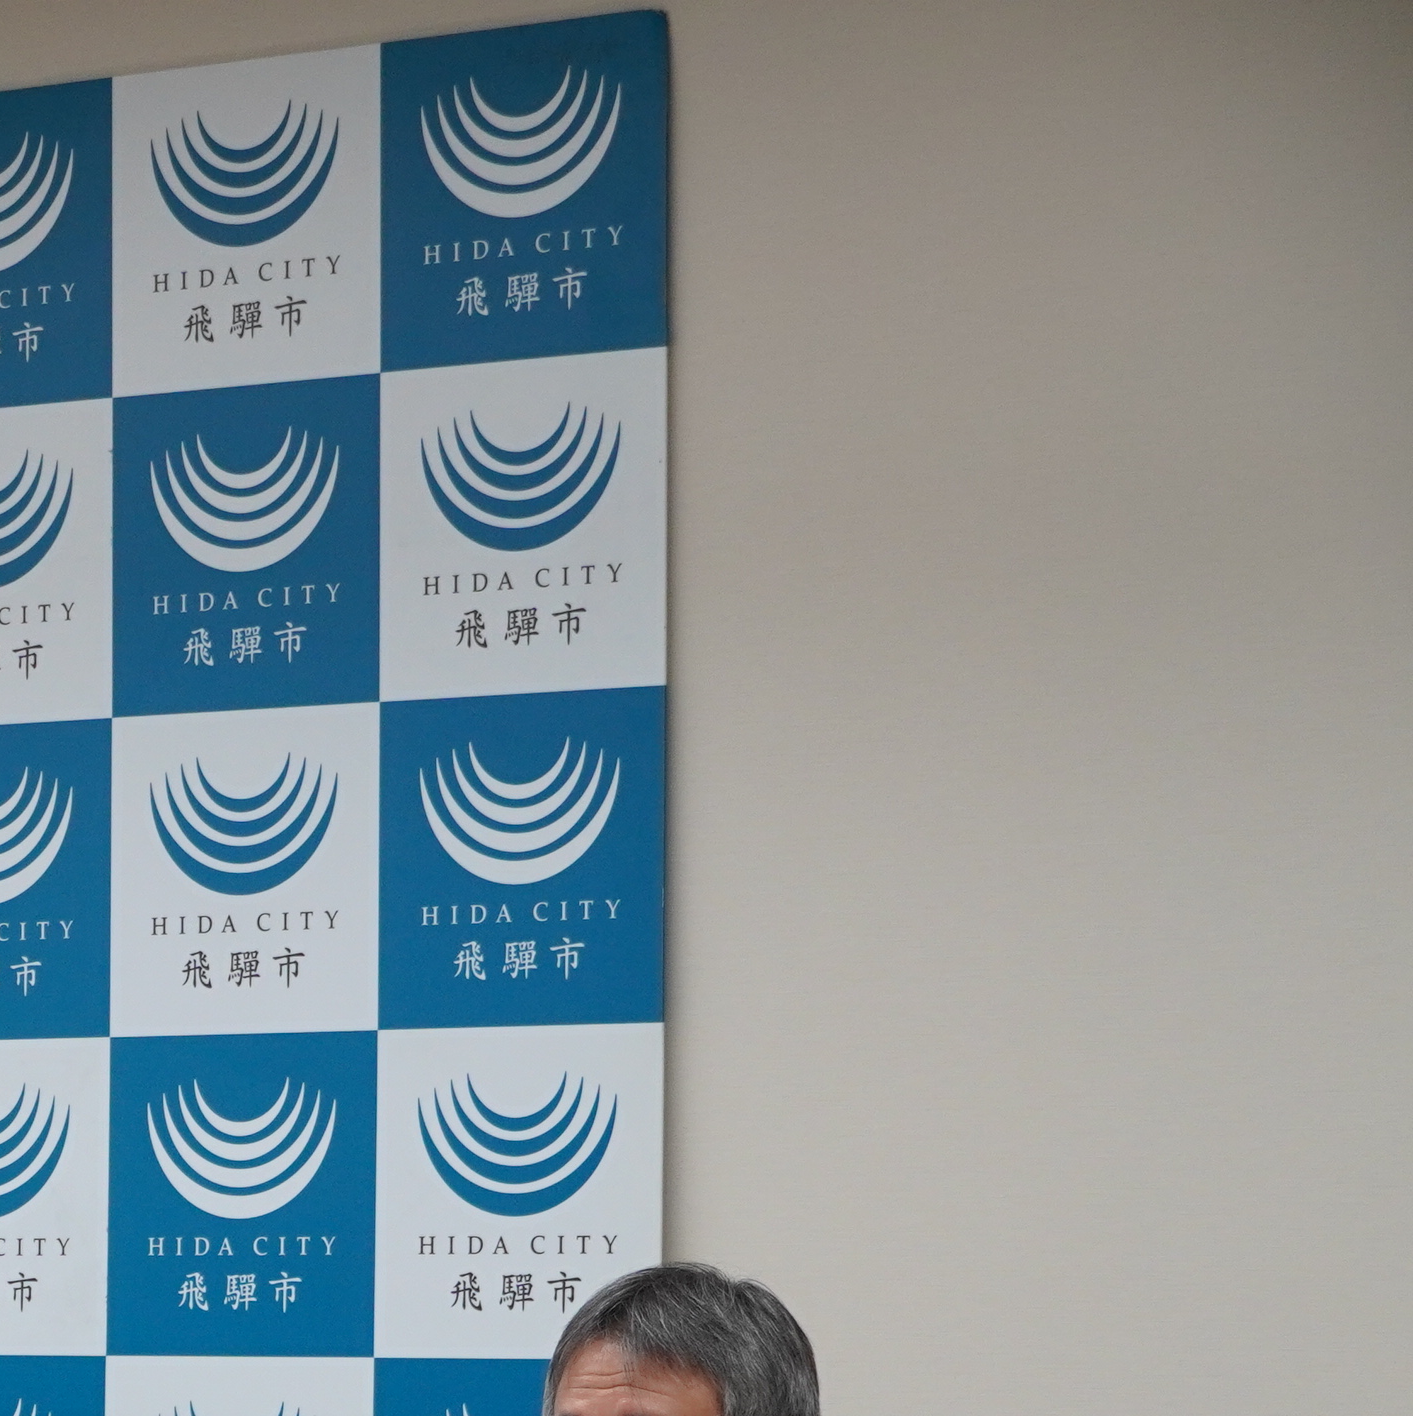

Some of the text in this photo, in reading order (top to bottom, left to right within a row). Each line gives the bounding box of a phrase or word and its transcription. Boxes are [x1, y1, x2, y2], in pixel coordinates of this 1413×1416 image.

[424, 226, 622, 265] HIDA CITY
[153, 255, 340, 293] HIDA CITY
[423, 563, 622, 595] HIDA CITY
[153, 583, 340, 615] HIDA CITY
[151, 910, 338, 935] HIDA CITY
[421, 899, 620, 925] HIDA CITY
[148, 1236, 335, 1256] HIDA CITY
[419, 1235, 617, 1255] HIDA CITY
